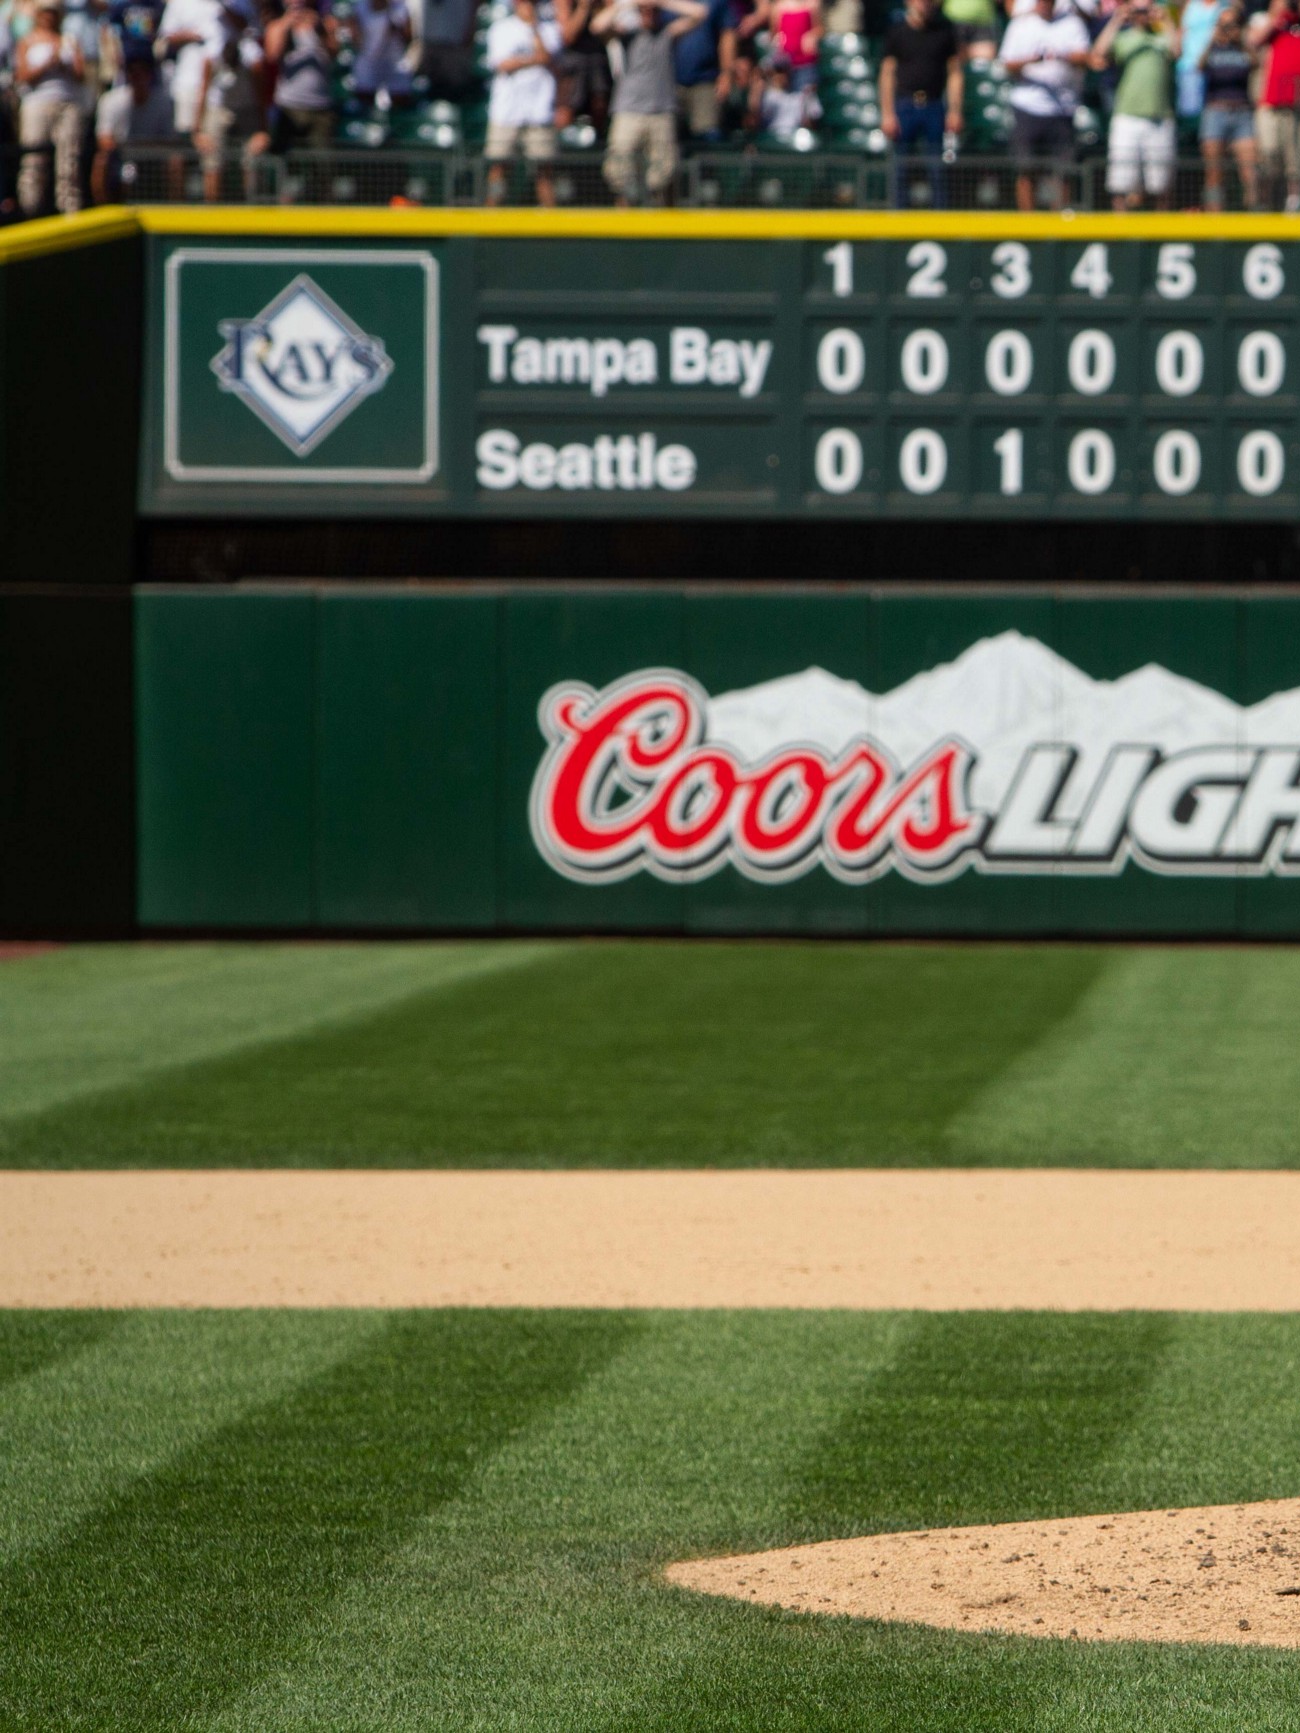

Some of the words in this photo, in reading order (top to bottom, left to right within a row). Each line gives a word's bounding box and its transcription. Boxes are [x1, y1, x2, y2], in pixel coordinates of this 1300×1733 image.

[825, 242, 853, 297] 1
[907, 241, 946, 298] 2
[992, 242, 1031, 298] 3
[1071, 243, 1112, 298] 4
[1156, 243, 1196, 299] 5
[1243, 243, 1284, 300] 6
[478, 325, 657, 397] Tampa
[670, 327, 771, 397] Bay
[817, 328, 865, 394] 0
[901, 329, 949, 394] 0
[985, 329, 1032, 395] 0
[1068, 329, 1116, 395] 0
[1155, 330, 1203, 396] 0
[1237, 330, 1285, 396] 0
[476, 429, 696, 490] Seattle
[815, 428, 863, 494] 0
[899, 428, 947, 494] 0
[994, 428, 1022, 495] 1
[1068, 429, 1115, 494] 0
[1154, 430, 1201, 494] 0
[1237, 430, 1284, 496] 0
[544, 683, 975, 858] Coors
